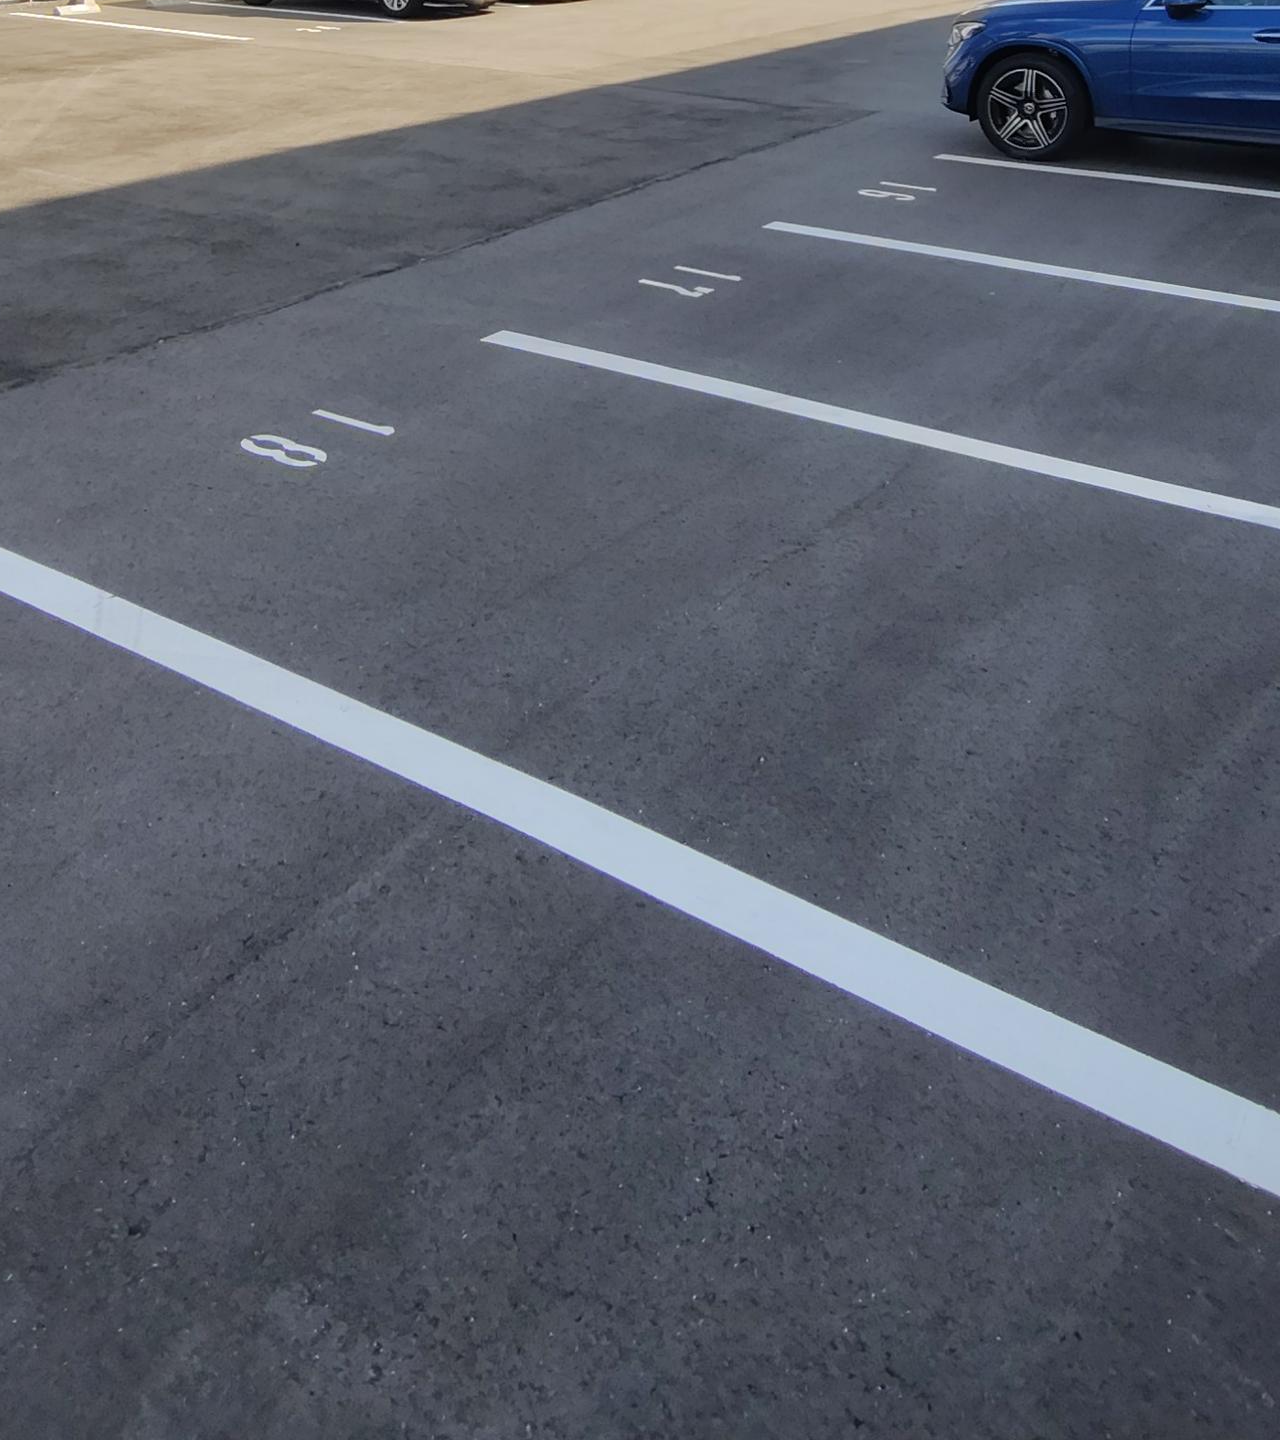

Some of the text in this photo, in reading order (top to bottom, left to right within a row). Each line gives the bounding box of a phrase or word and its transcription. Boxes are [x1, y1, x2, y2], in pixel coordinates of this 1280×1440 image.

[857, 180, 937, 201] 16
[637, 264, 743, 298] 17
[239, 408, 396, 469] 18
